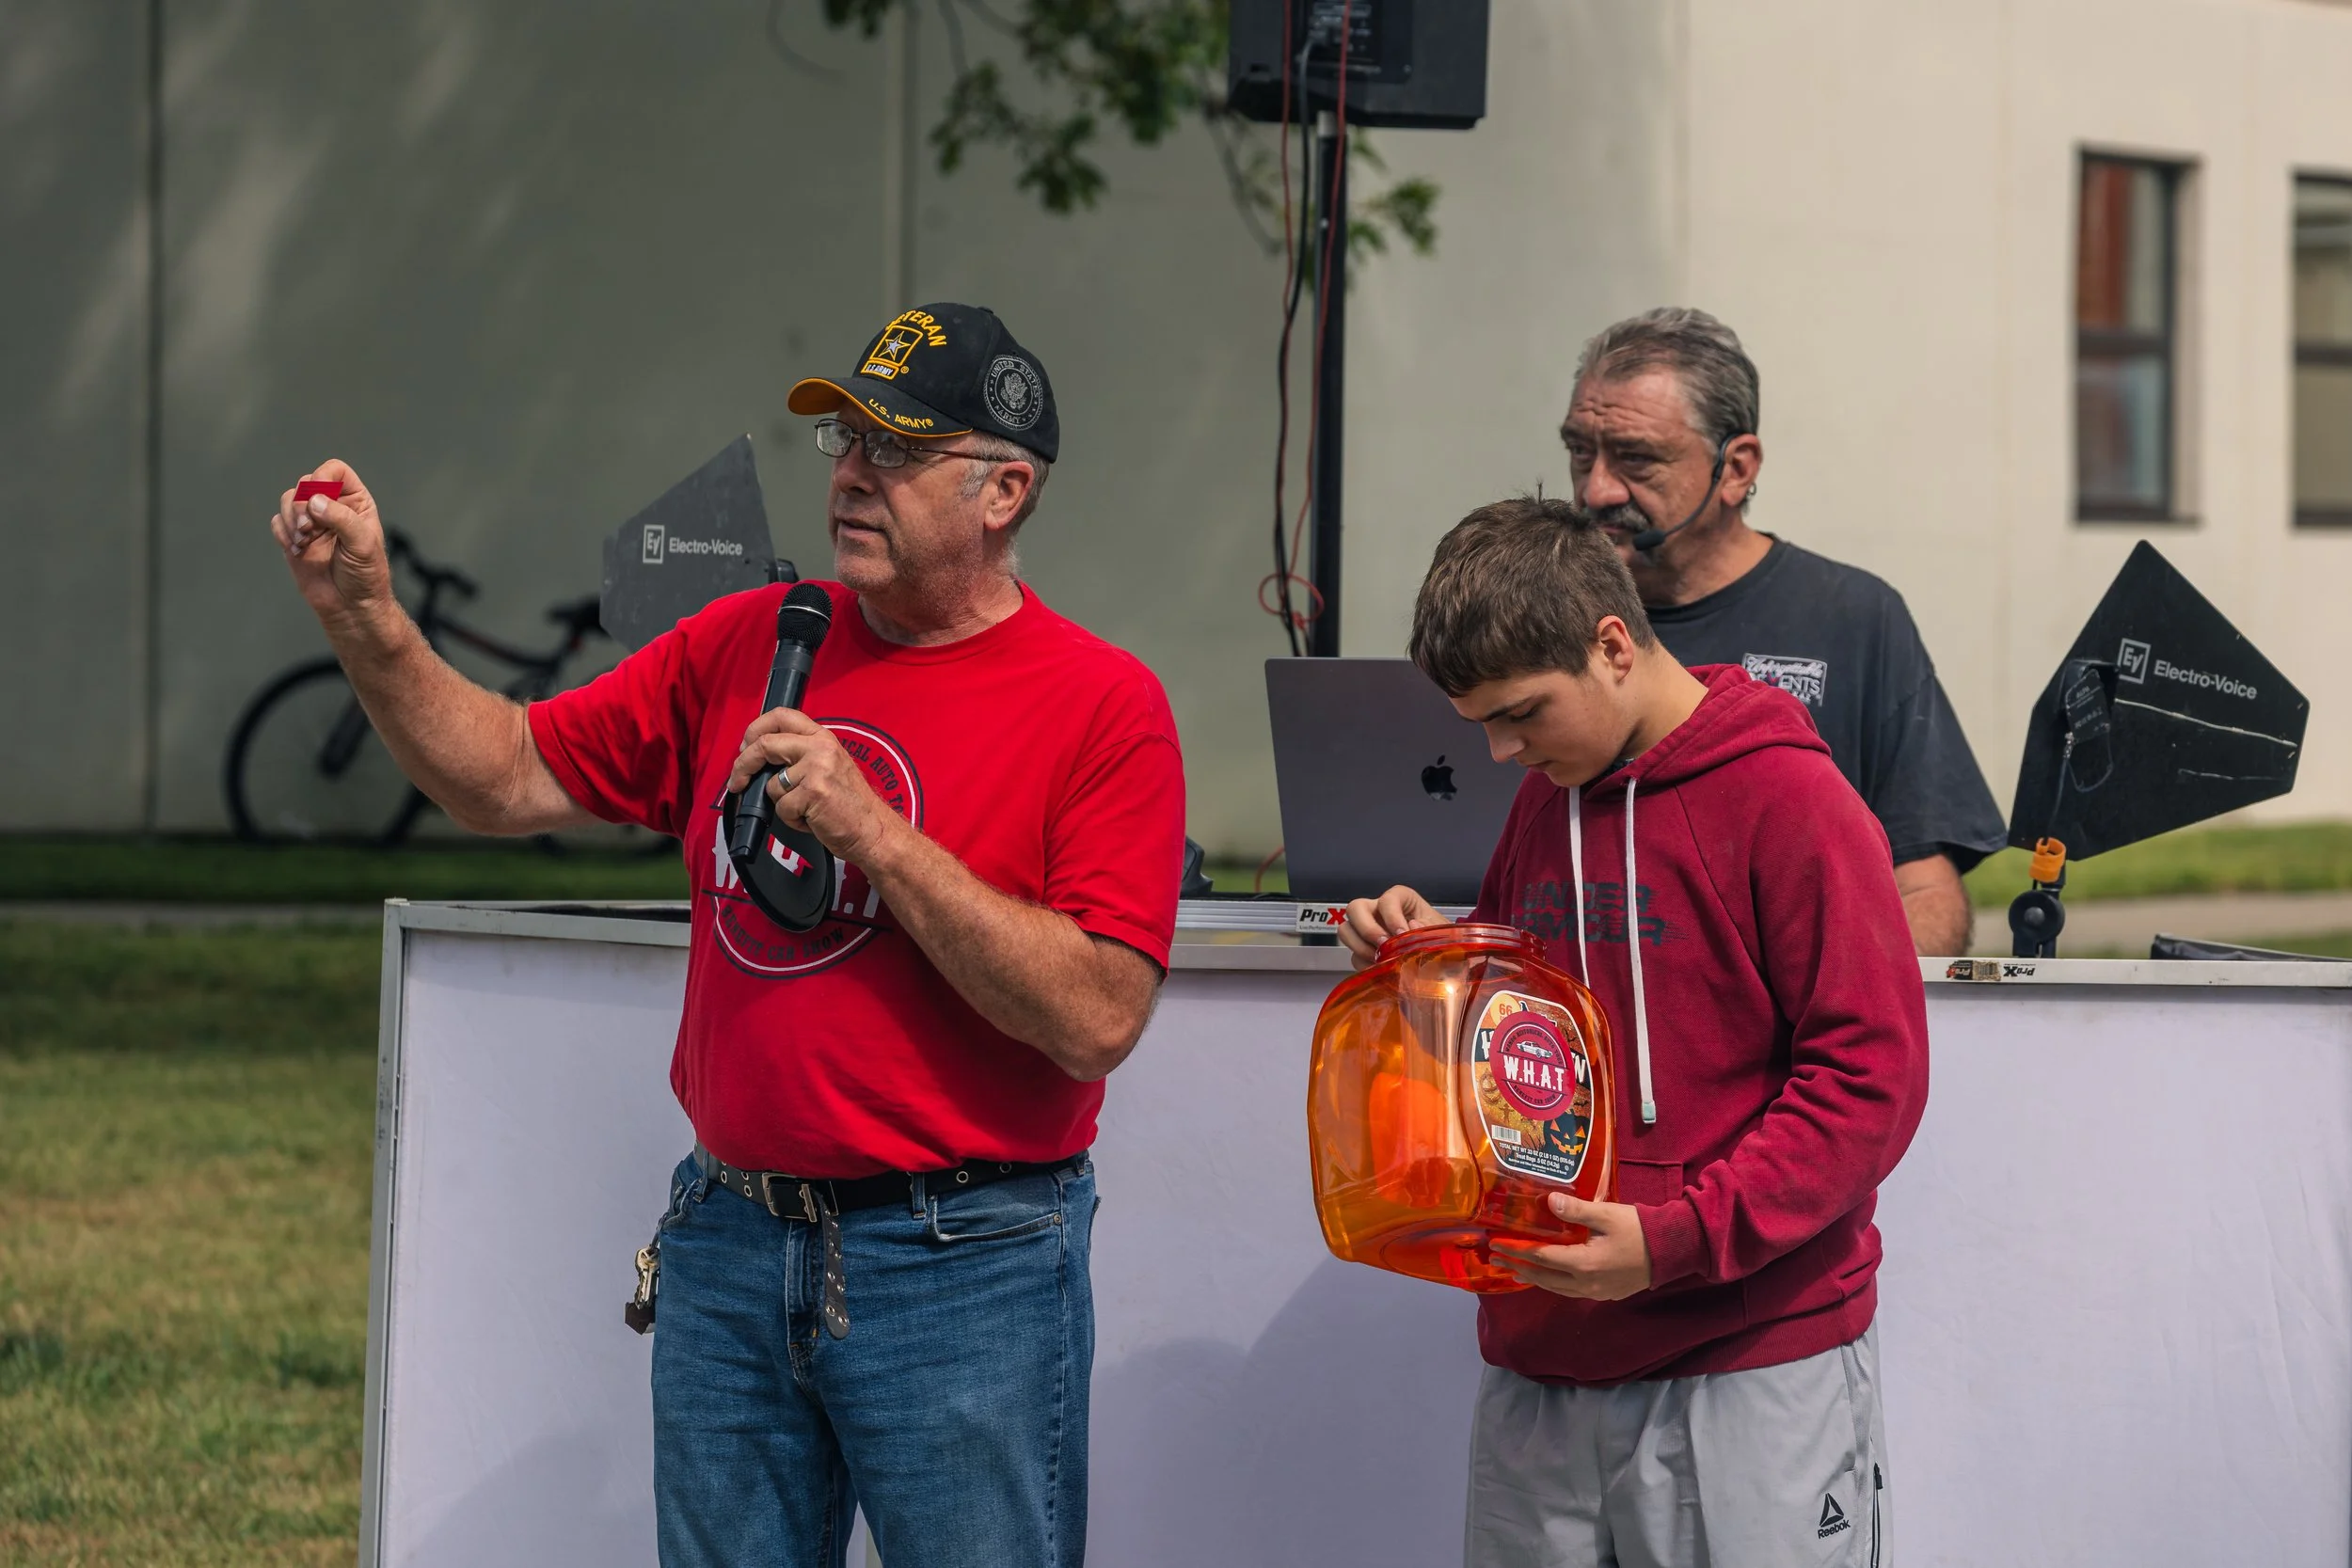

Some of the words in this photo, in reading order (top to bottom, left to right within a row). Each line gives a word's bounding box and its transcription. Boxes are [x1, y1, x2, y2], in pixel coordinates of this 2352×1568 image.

[668, 537, 743, 556] Electro-Voice
[2153, 659, 2258, 700] Electro-Voice
[869, 755, 898, 790] AUTO
[1299, 908, 1347, 925] ProX
[721, 904, 764, 957] BENEFIT
[767, 945, 795, 962] CAR
[803, 926, 844, 958] SHOW
[2003, 966, 2036, 976] ProX
[1499, 1004, 1513, 1015] 66
[1503, 1054, 1565, 1091] W.H.A.T
[1817, 1519, 1851, 1539] Reebok
